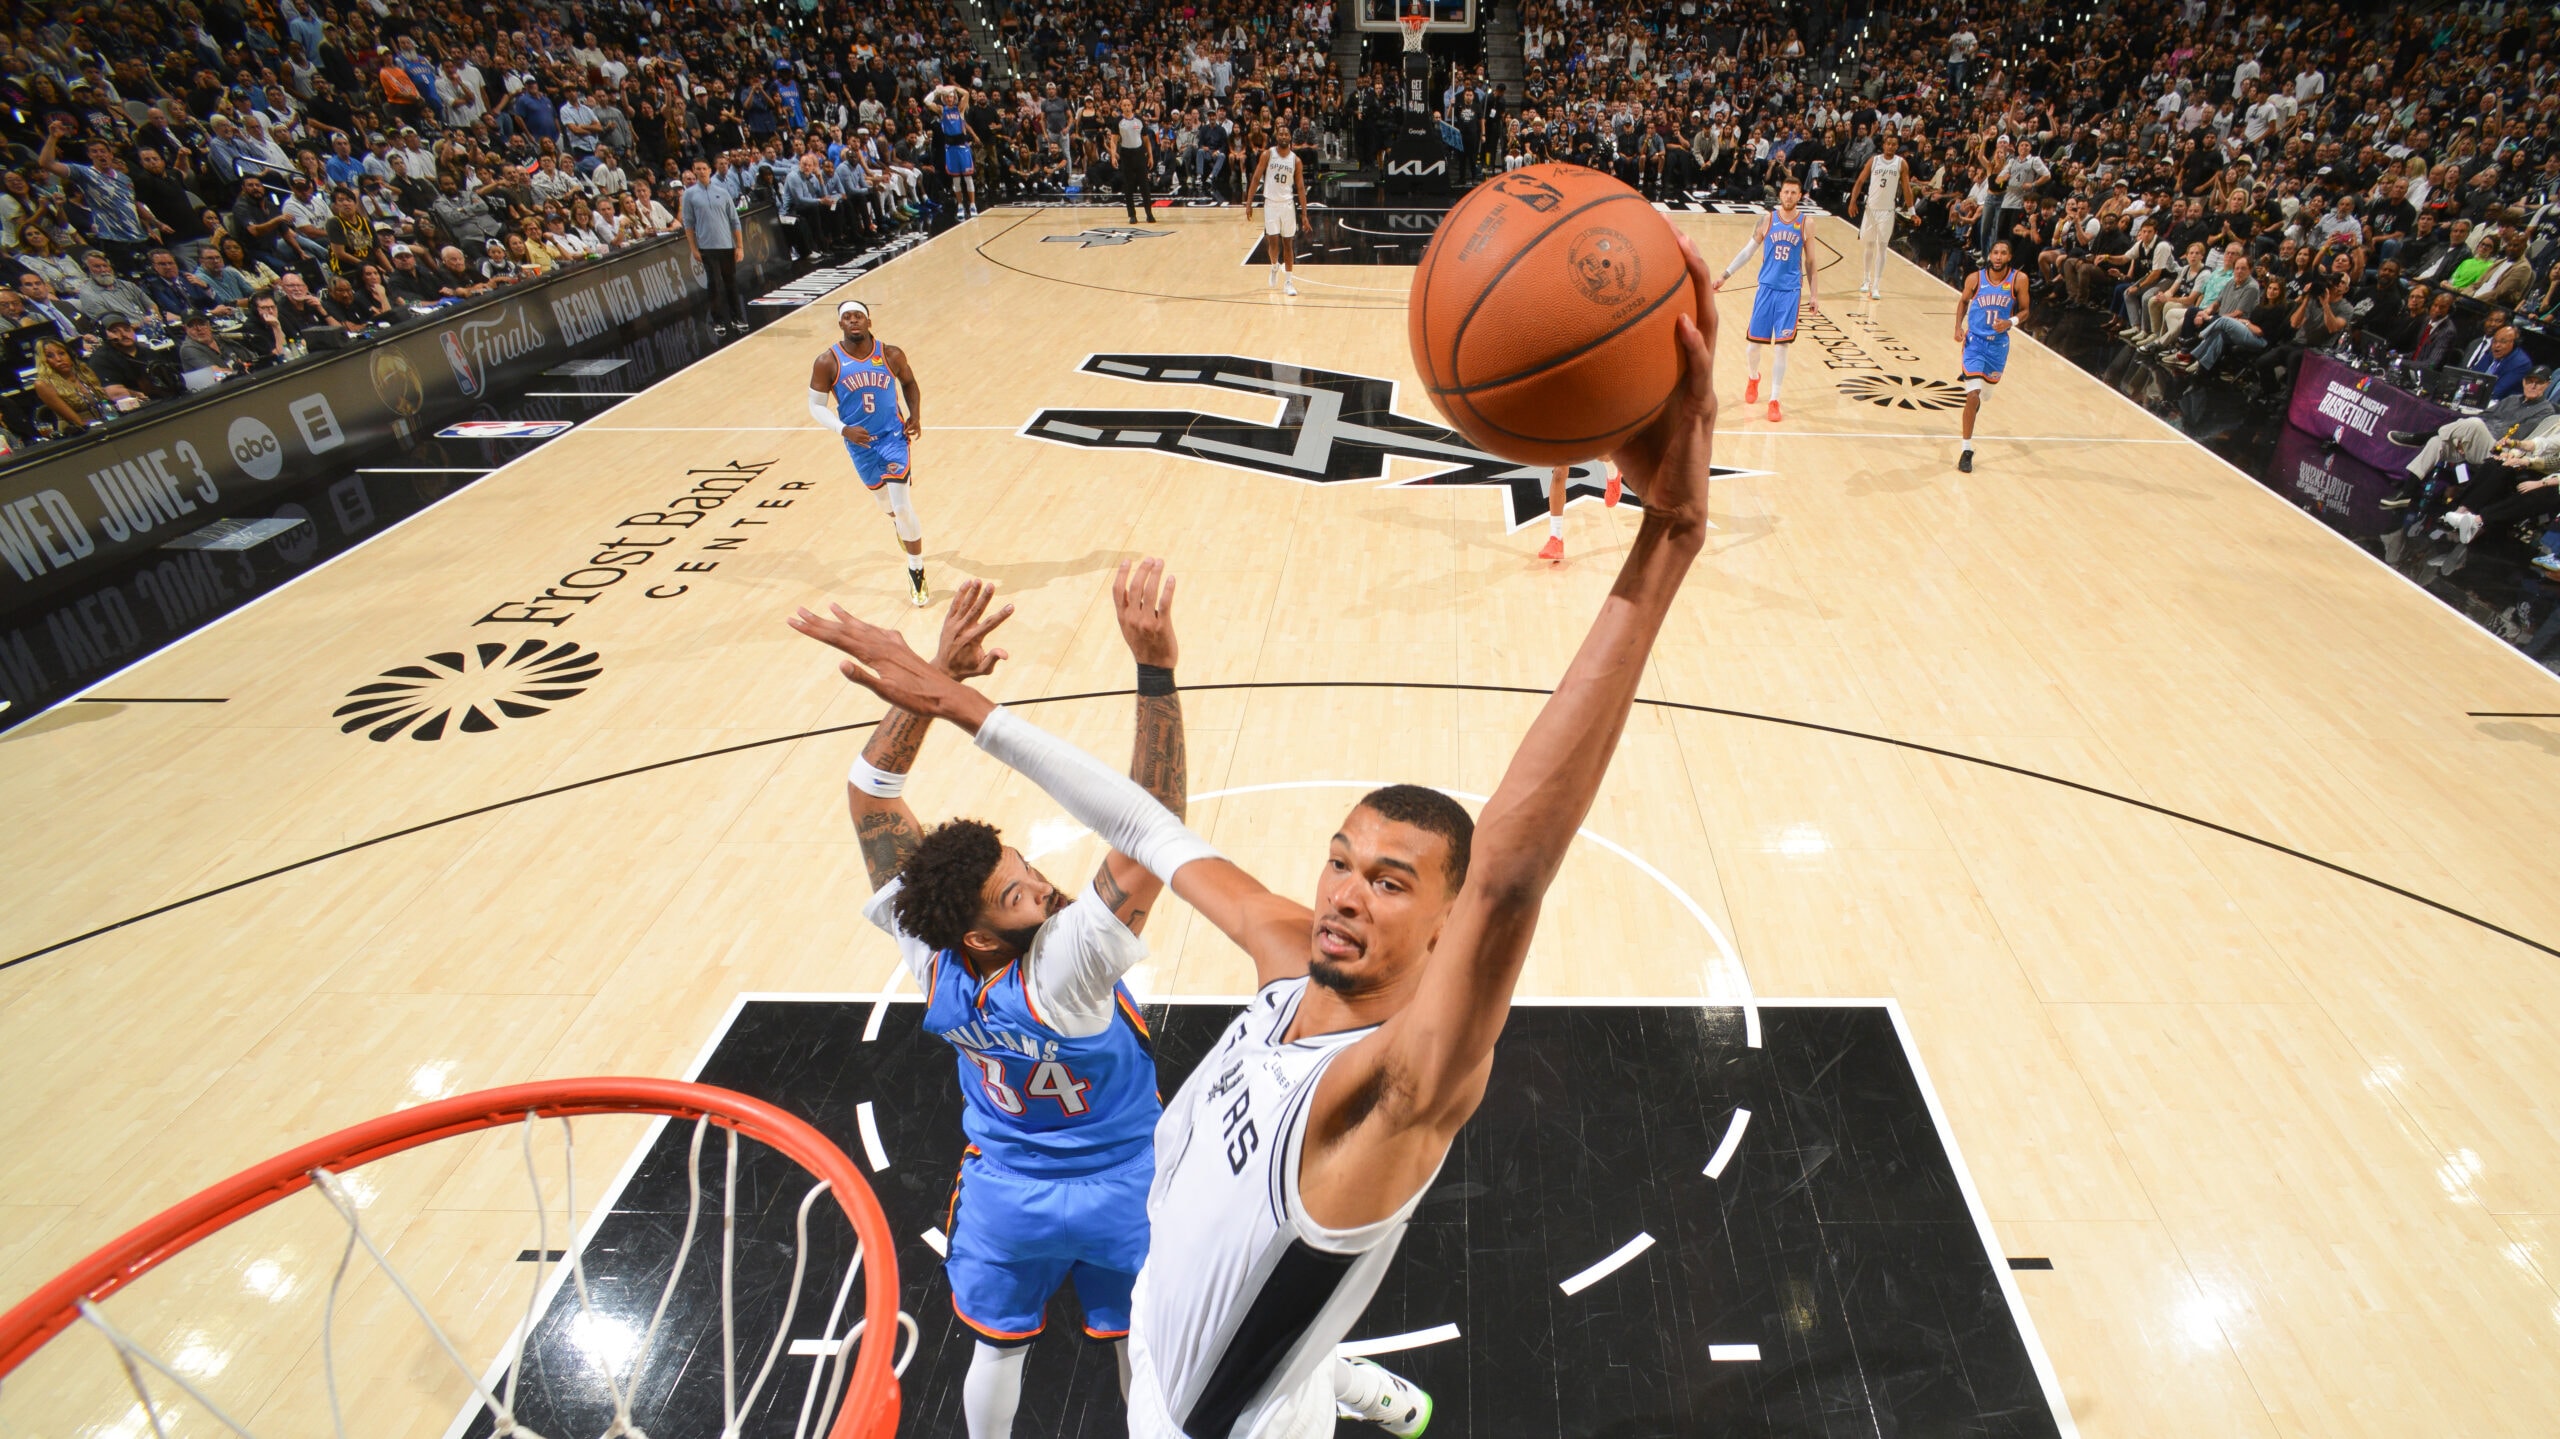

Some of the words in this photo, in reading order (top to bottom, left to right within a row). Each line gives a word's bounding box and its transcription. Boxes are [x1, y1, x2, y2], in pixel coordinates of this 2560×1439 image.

[1411, 80, 1423, 90] GET
[1411, 90, 1423, 101] THE
[1408, 128, 1426, 136] Google
[1388, 160, 1446, 175] KIA
[1274, 173, 1287, 184] 40
[1880, 178, 1887, 188] 3
[1769, 231, 1800, 246] THUNDER
[1774, 245, 1791, 262] 55
[1976, 293, 2012, 309] THUNDER
[1986, 309, 1999, 325] 11
[461, 305, 545, 400] Finals
[551, 287, 608, 347] BEGIN
[600, 275, 643, 327] WED
[639, 260, 675, 313] JUNE
[671, 256, 688, 299] 3
[1803, 335, 1884, 370] Frost
[842, 371, 891, 392] THUNDER
[862, 392, 876, 414] 5
[2327, 380, 2362, 403] SUNDAY
[2360, 394, 2389, 417] NIGHT
[2318, 392, 2380, 437] BASKETBALL
[0, 488, 95, 582] WED
[88, 448, 198, 542] JUNE
[175, 439, 220, 505] 3
[235, 434, 276, 464] abc
[470, 536, 676, 628] Frost
[615, 458, 781, 529] Bank
[645, 481, 817, 600] CENTER
[960, 1043, 1092, 1117] 34
